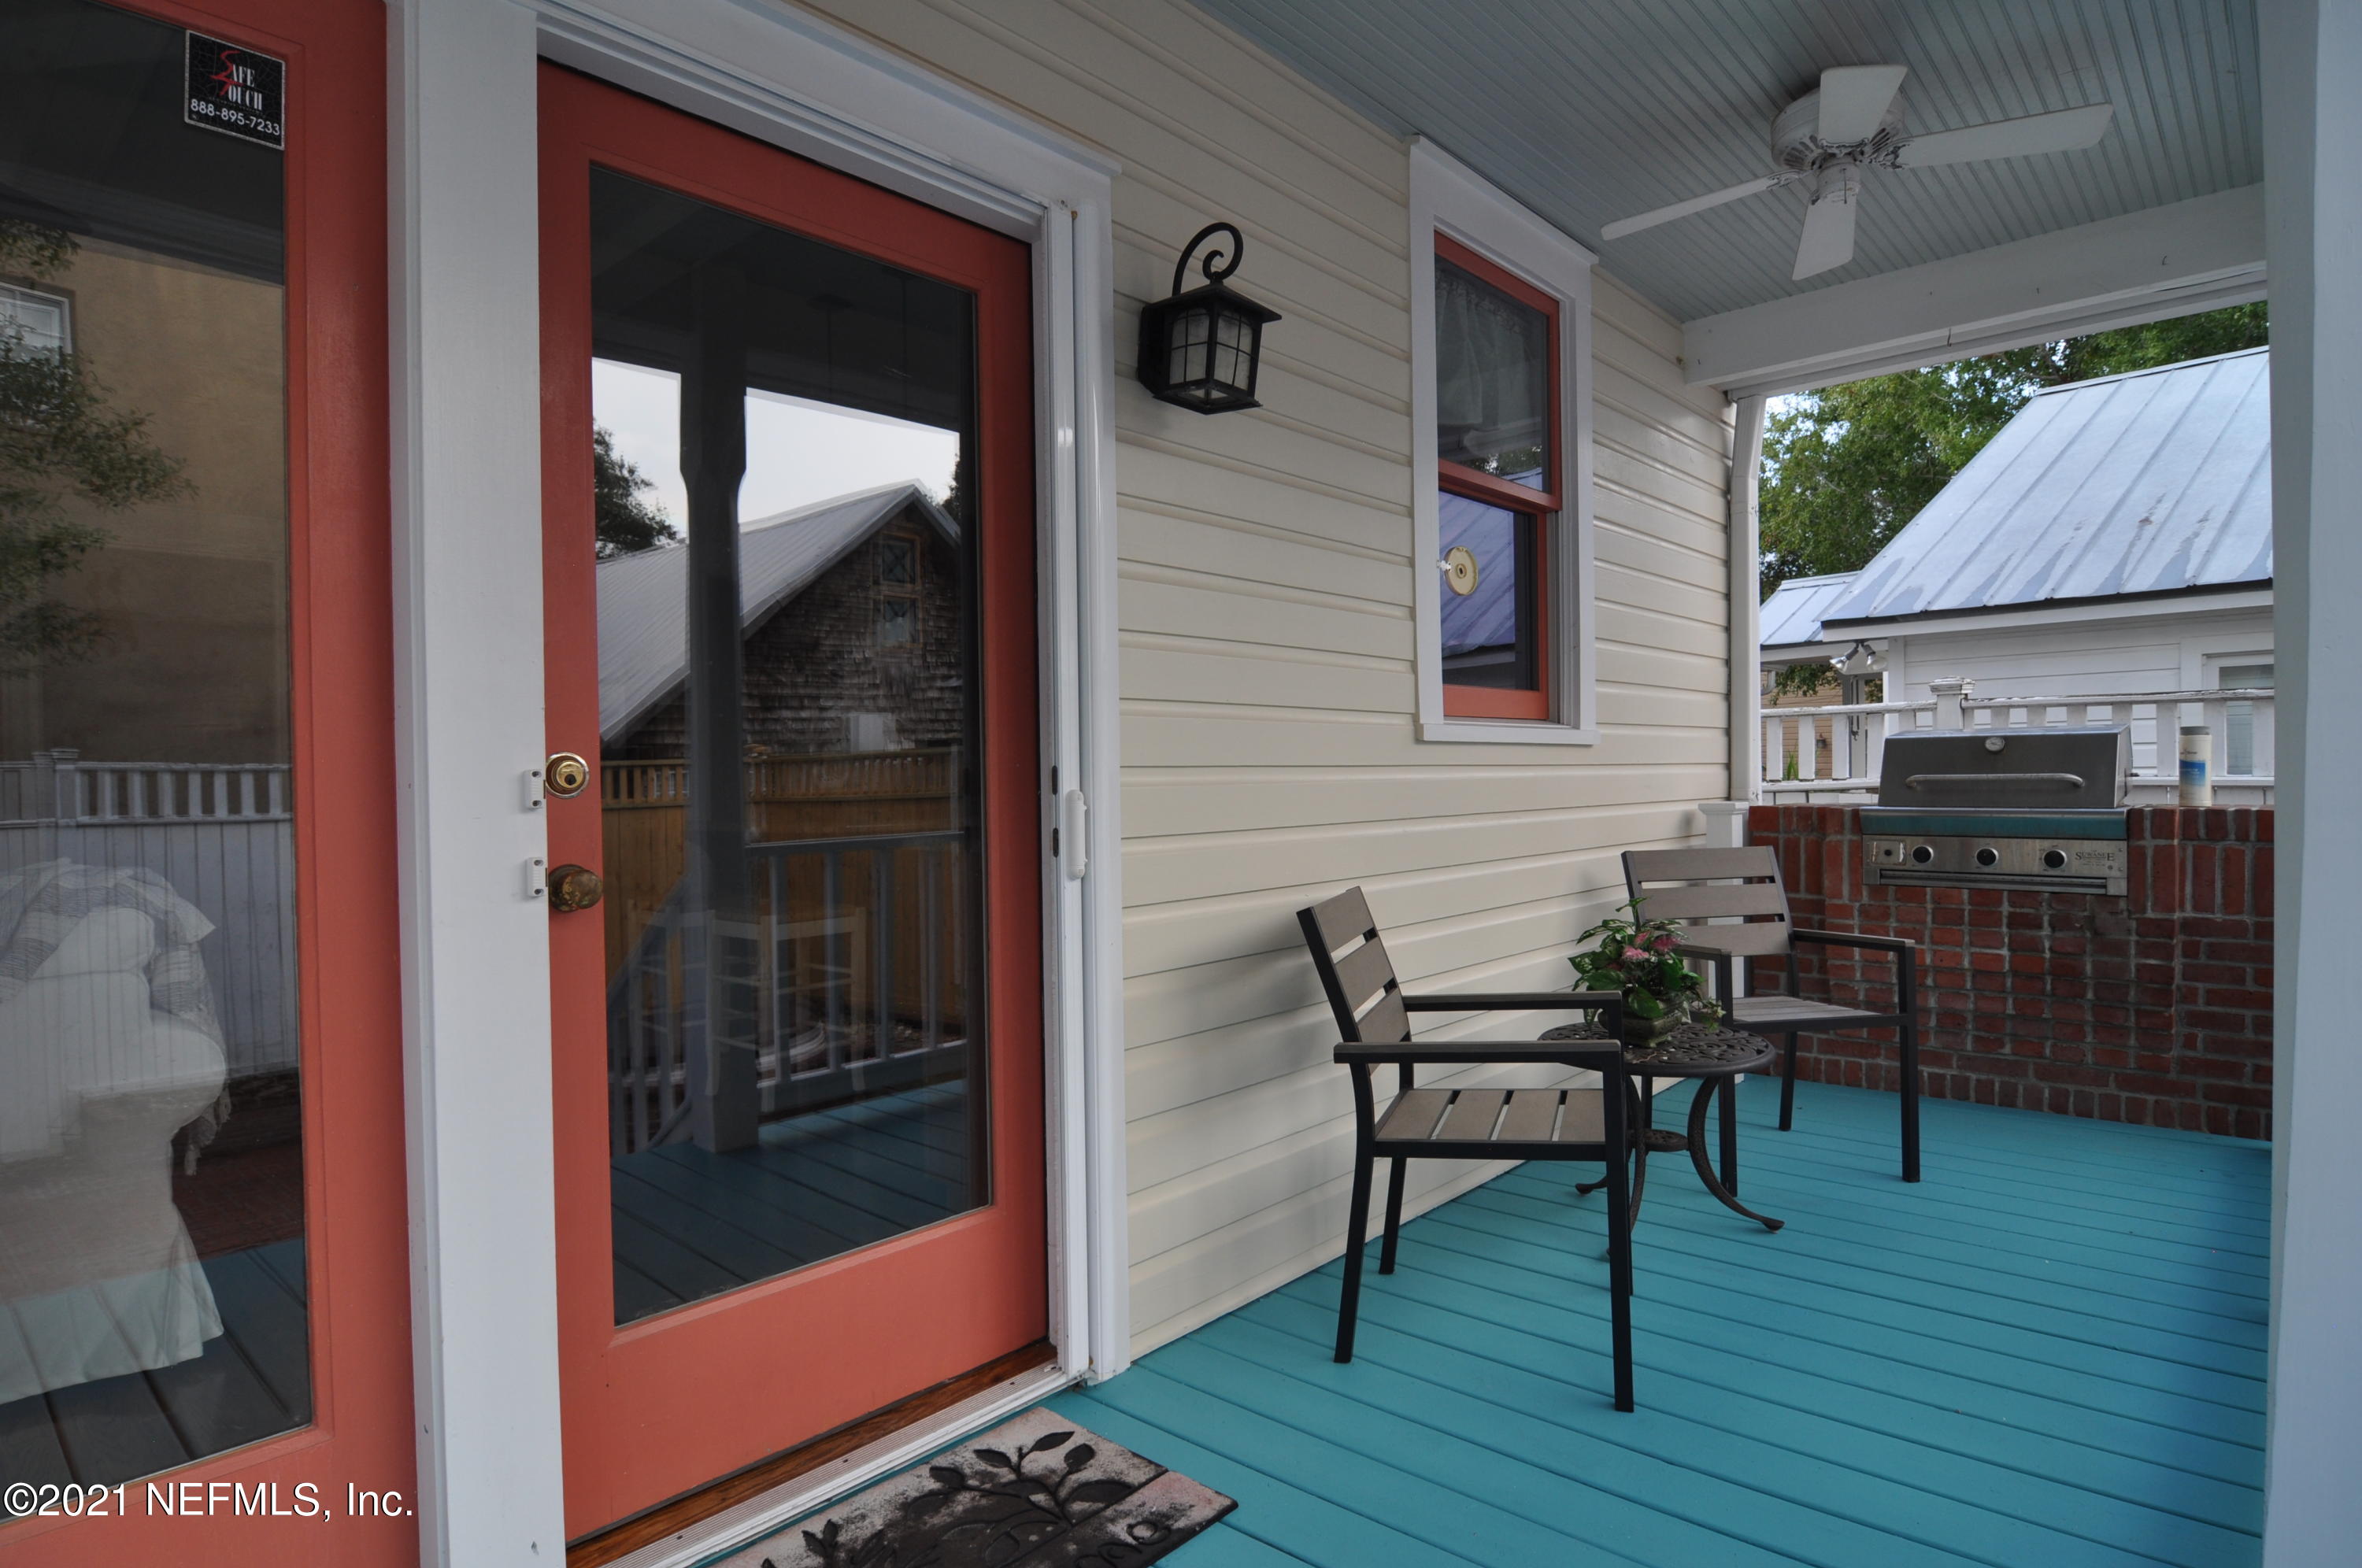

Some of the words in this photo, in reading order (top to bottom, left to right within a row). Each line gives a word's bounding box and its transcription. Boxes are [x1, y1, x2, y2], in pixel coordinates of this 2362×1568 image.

[209, 50, 255, 87] SAFE
[209, 75, 263, 111] TOUCH
[191, 98, 280, 135] 888-895-7233
